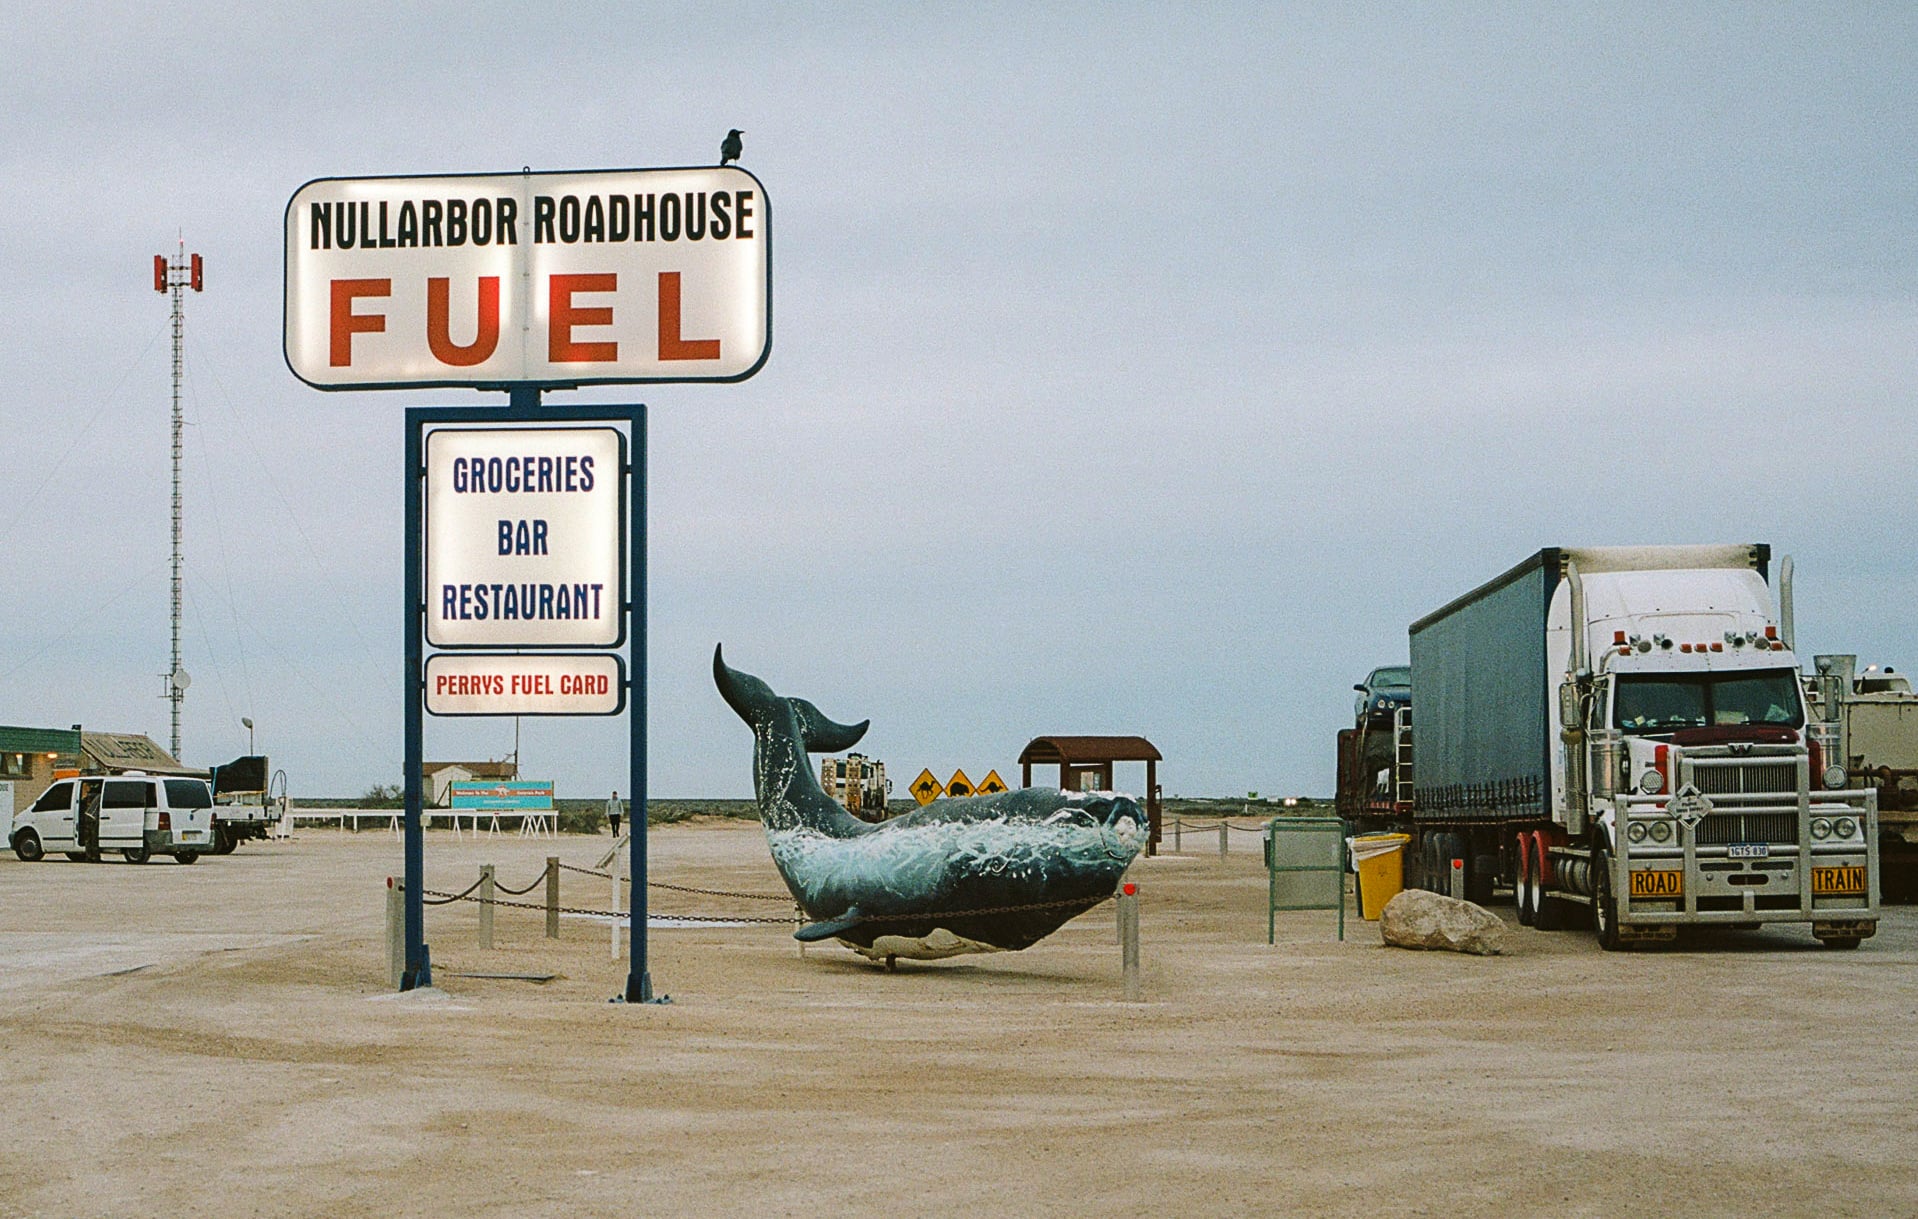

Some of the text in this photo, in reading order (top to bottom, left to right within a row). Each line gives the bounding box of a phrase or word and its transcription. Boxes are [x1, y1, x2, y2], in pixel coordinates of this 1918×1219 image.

[310, 190, 754, 250] NULLARBOR ROADHOUSE
[329, 271, 721, 368] FUEL
[453, 456, 595, 493] GROCERIES
[498, 519, 549, 556] BAR
[442, 583, 604, 620] RESTAURANT
[436, 674, 609, 696] PERRYS FUEL CARD
[1635, 873, 1677, 893] ROAD
[1816, 869, 1862, 890] TRAIN
